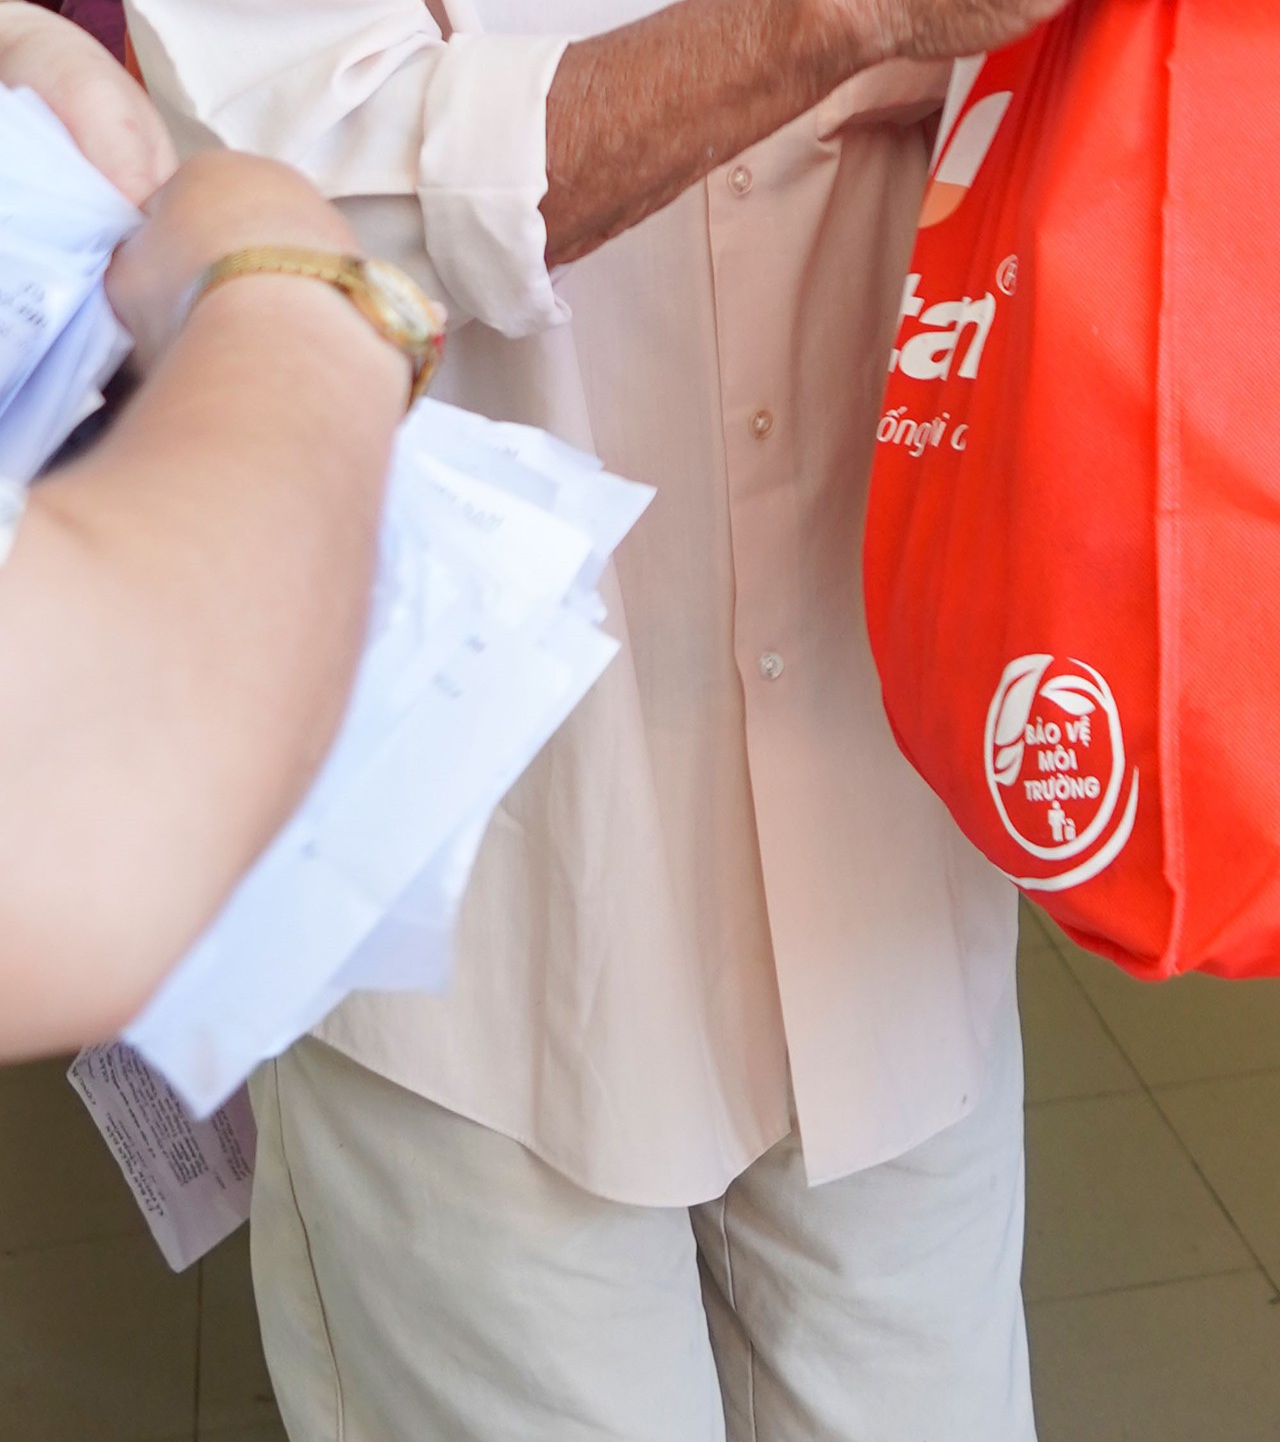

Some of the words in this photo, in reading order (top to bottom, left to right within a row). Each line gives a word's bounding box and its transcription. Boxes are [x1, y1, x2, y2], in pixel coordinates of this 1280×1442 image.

[1024, 715, 1062, 747] BẢO
[1065, 714, 1093, 748] VỆ
[1037, 744, 1079, 773] MÔI
